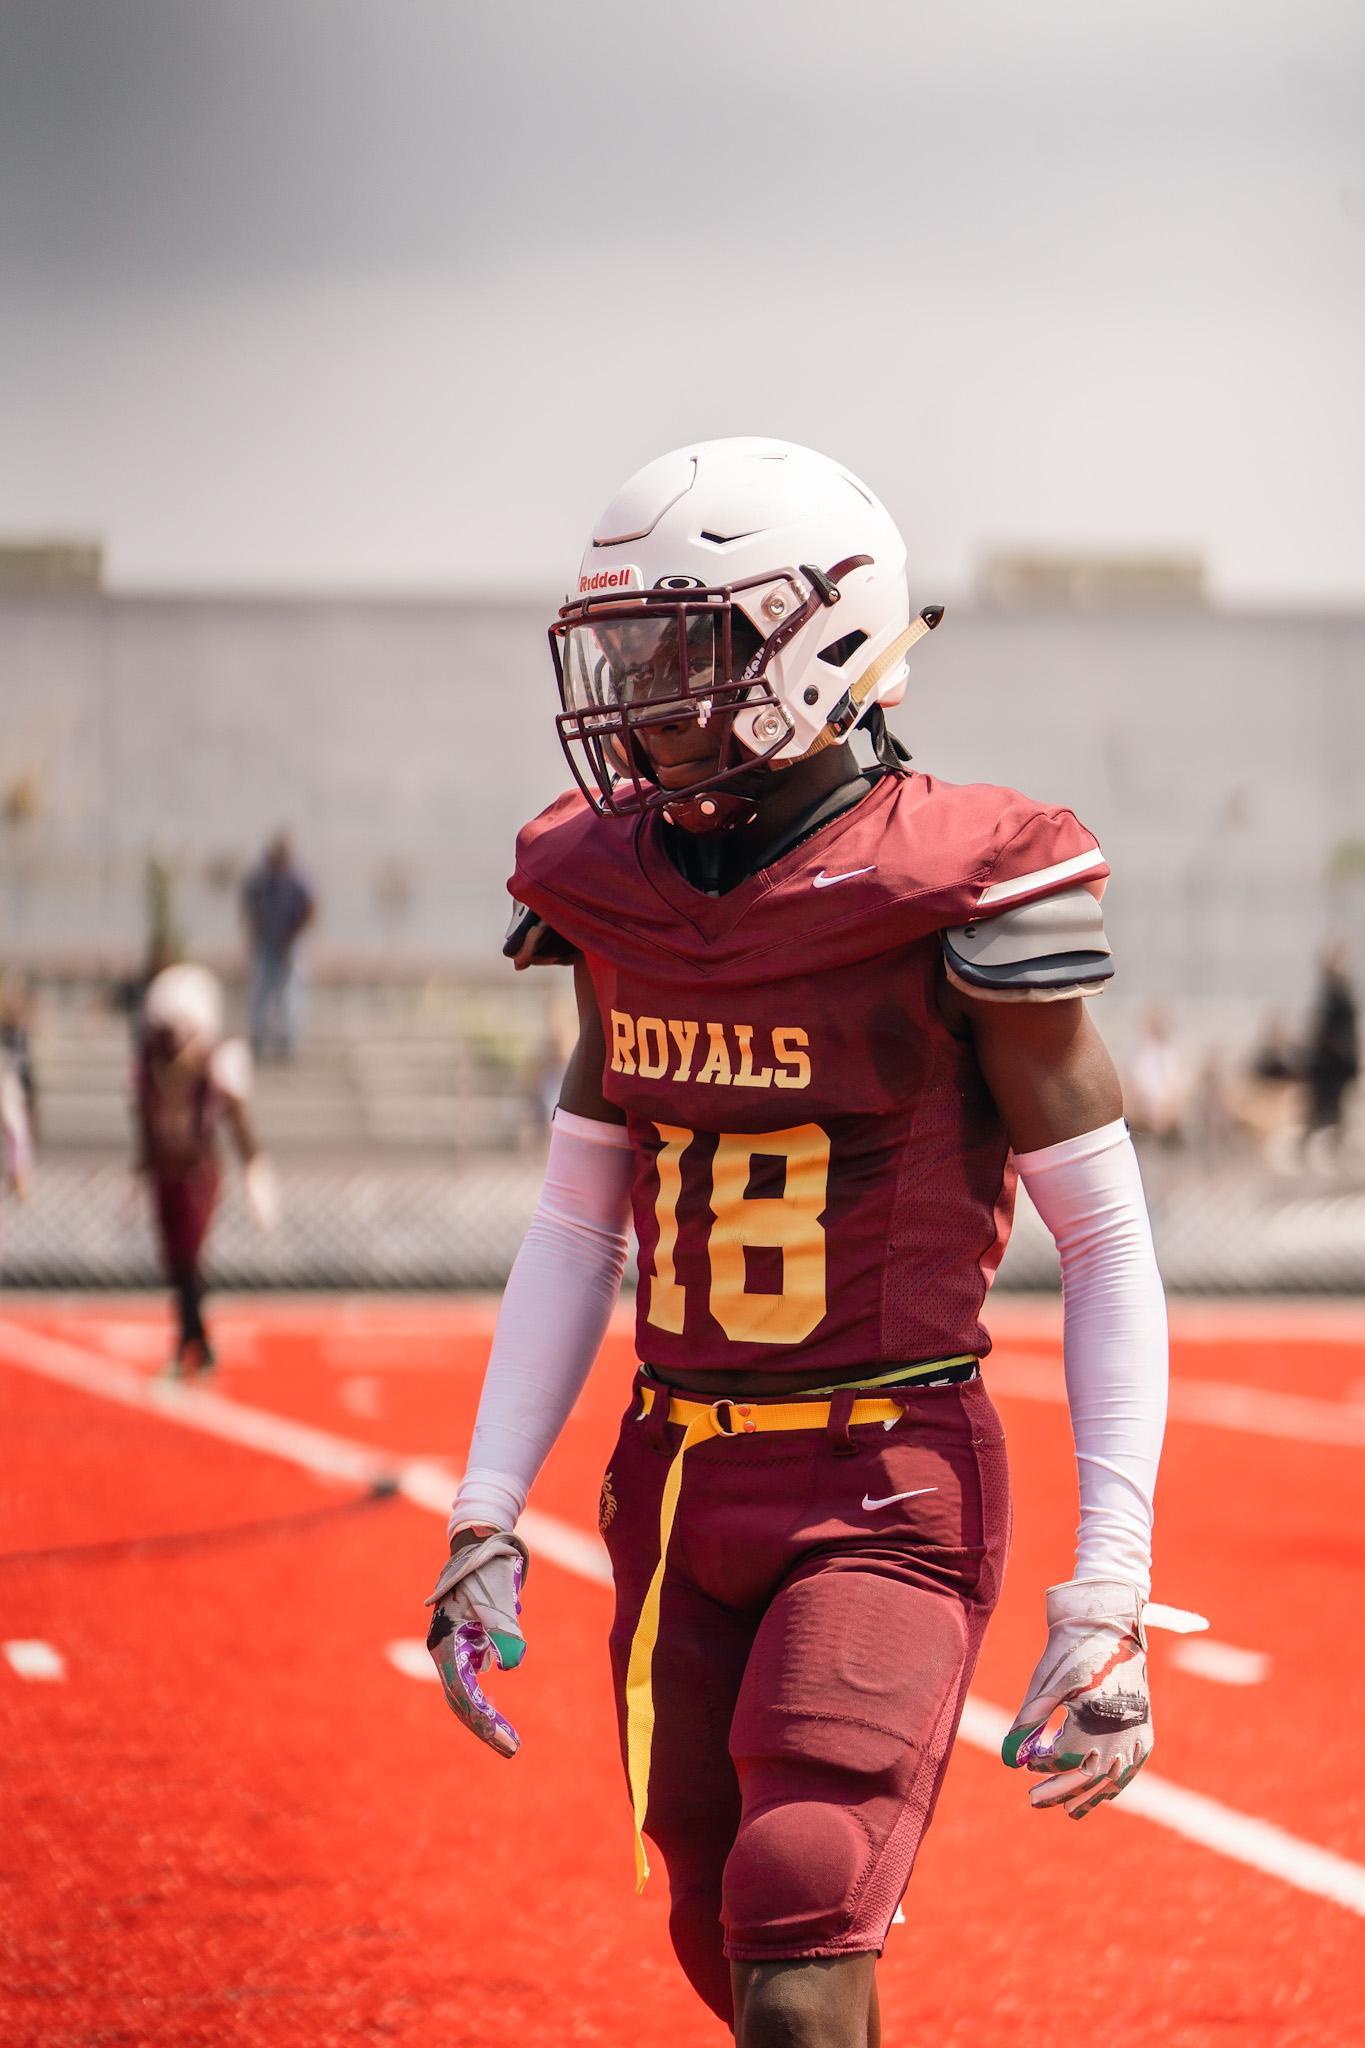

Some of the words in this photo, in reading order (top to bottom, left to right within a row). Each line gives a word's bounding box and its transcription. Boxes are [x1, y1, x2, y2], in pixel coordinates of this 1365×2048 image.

[579, 569, 630, 592] Riddell
[611, 1008, 812, 1089] ROYALS
[647, 1121, 831, 1344] 18
